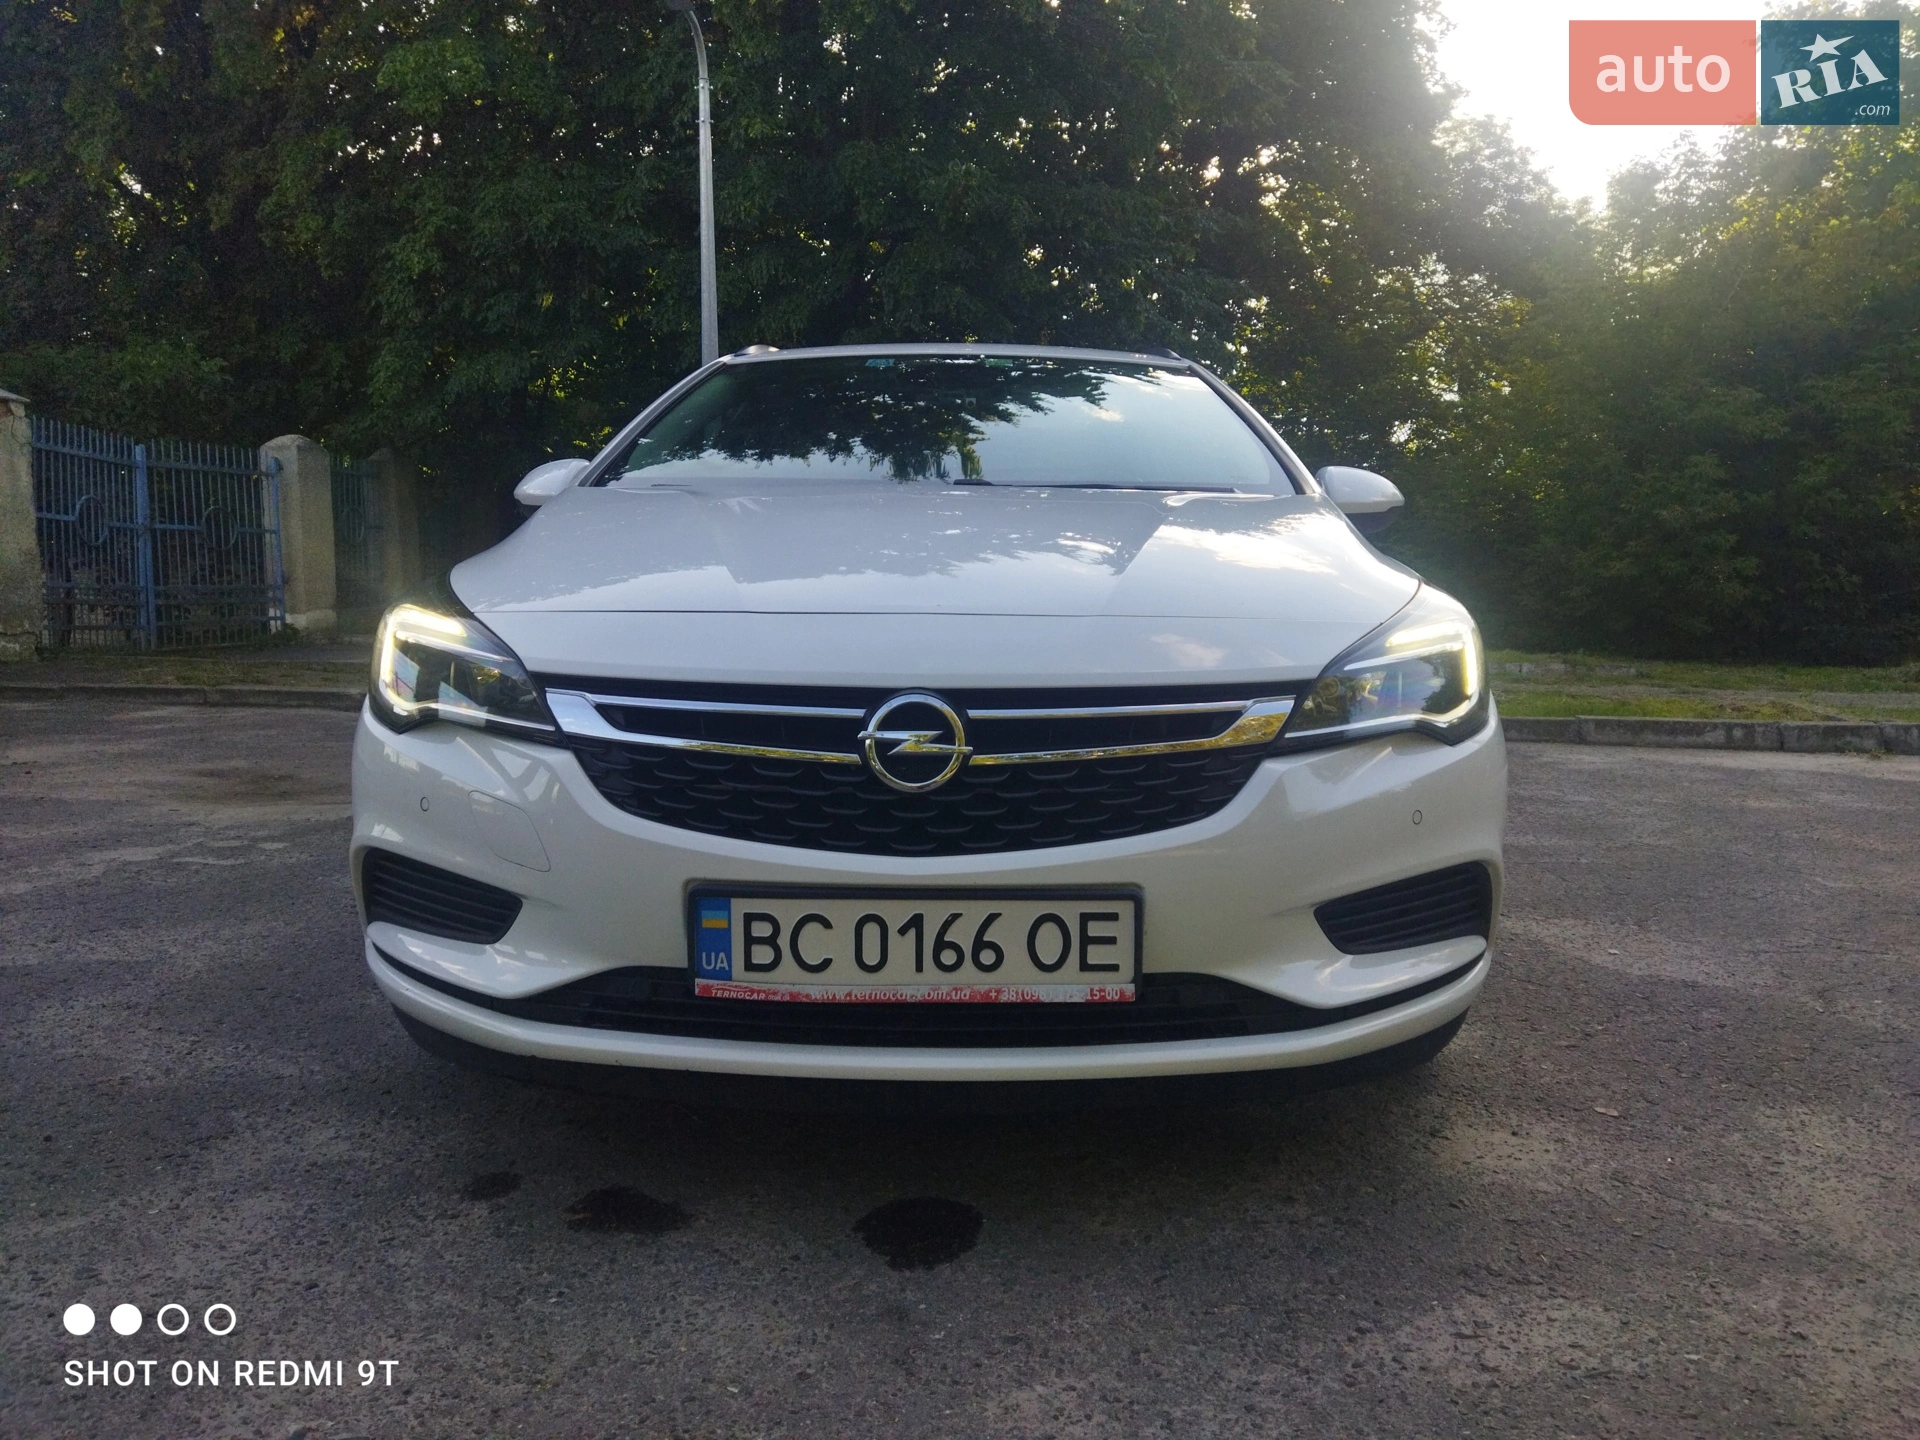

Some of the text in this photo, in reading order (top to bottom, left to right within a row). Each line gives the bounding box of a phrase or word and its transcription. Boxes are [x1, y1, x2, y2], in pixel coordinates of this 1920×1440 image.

[743, 912, 1120, 973] BC 0166 OE
[702, 952, 729, 971] UA
[711, 989, 766, 1001] TERNOCAR
